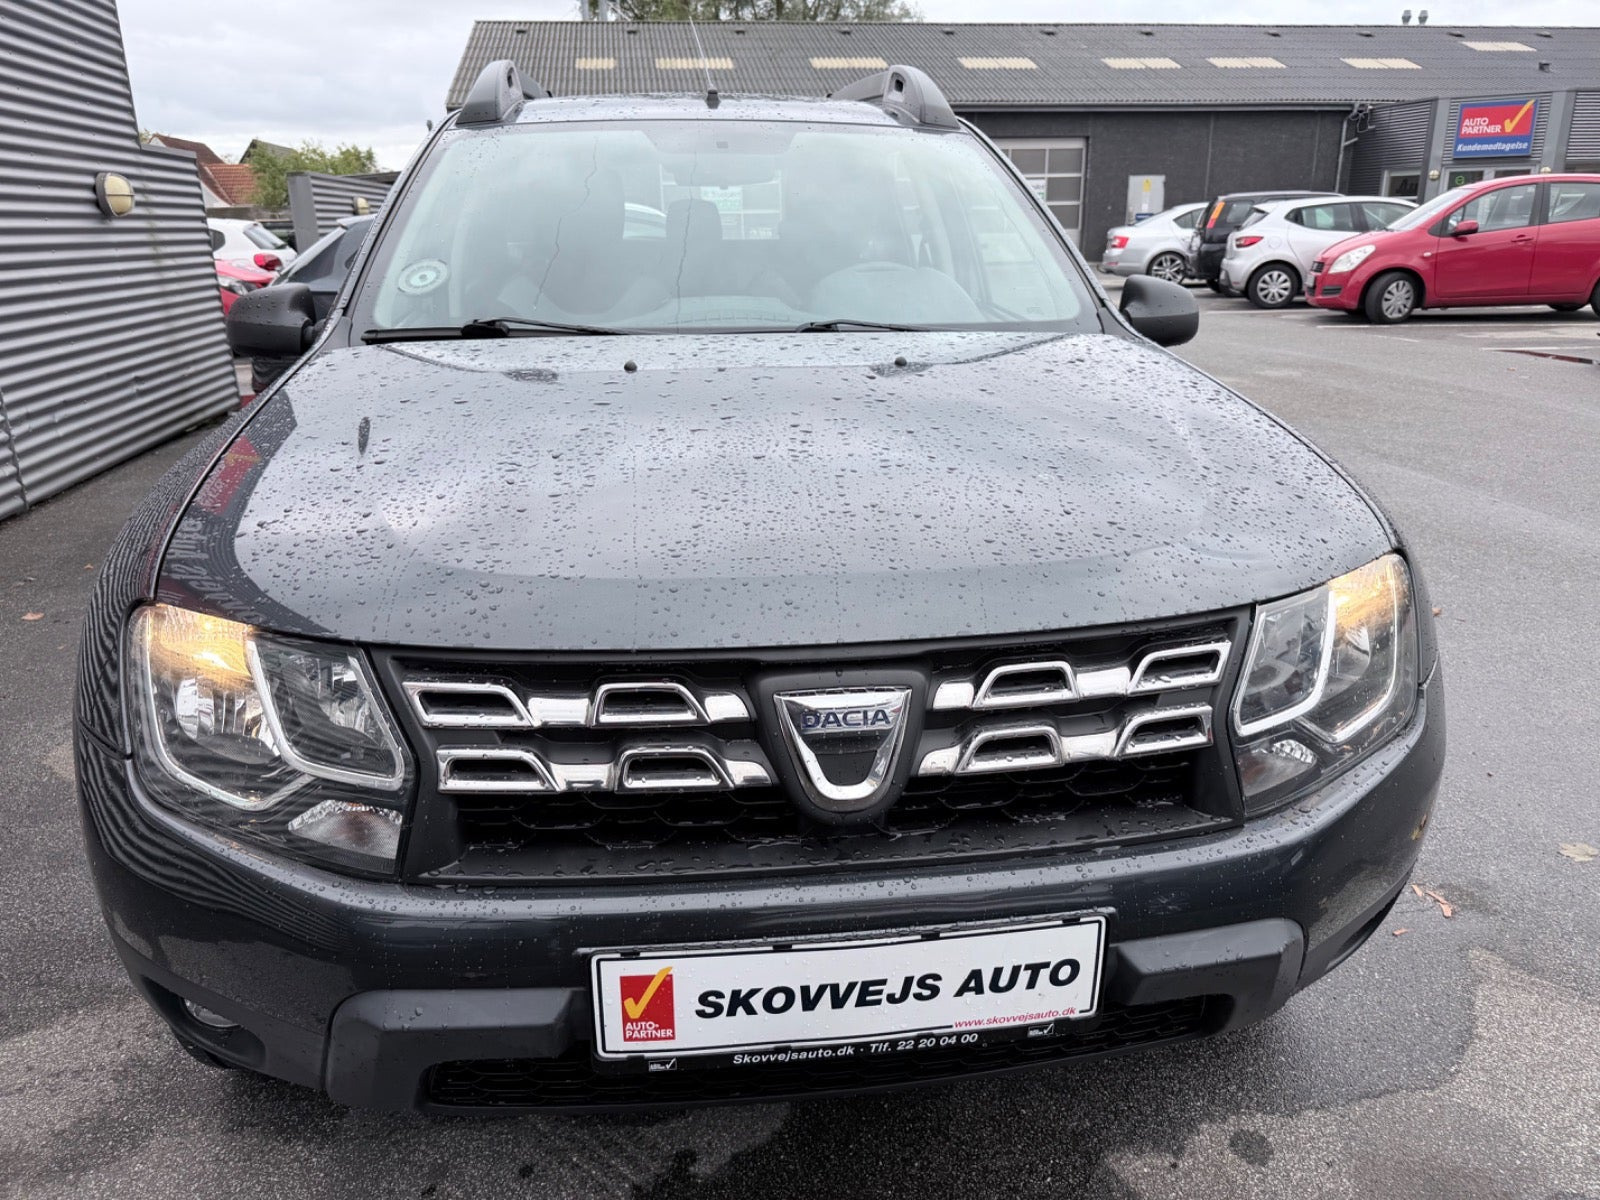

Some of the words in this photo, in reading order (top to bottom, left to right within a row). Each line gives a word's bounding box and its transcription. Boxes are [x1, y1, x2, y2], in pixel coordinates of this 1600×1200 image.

[1463, 117, 1489, 126] AUTO
[1461, 125, 1502, 134] PARTNER
[1456, 141, 1528, 152] Kundemodtagelse
[801, 709, 891, 729] DACIA
[695, 973, 943, 1019] SKOVVEJS
[953, 958, 1081, 998] AUTO
[954, 1006, 1077, 1029] www.skovvejsauto.dk
[625, 1028, 673, 1039] PARTNER
[733, 1046, 855, 1064] Skovvejsauto.dk
[870, 1042, 892, 1053] Tlf.
[896, 1040, 914, 1051] 22
[917, 1038, 936, 1049] 20
[939, 1035, 958, 1046] 04
[960, 1033, 979, 1043] 00
